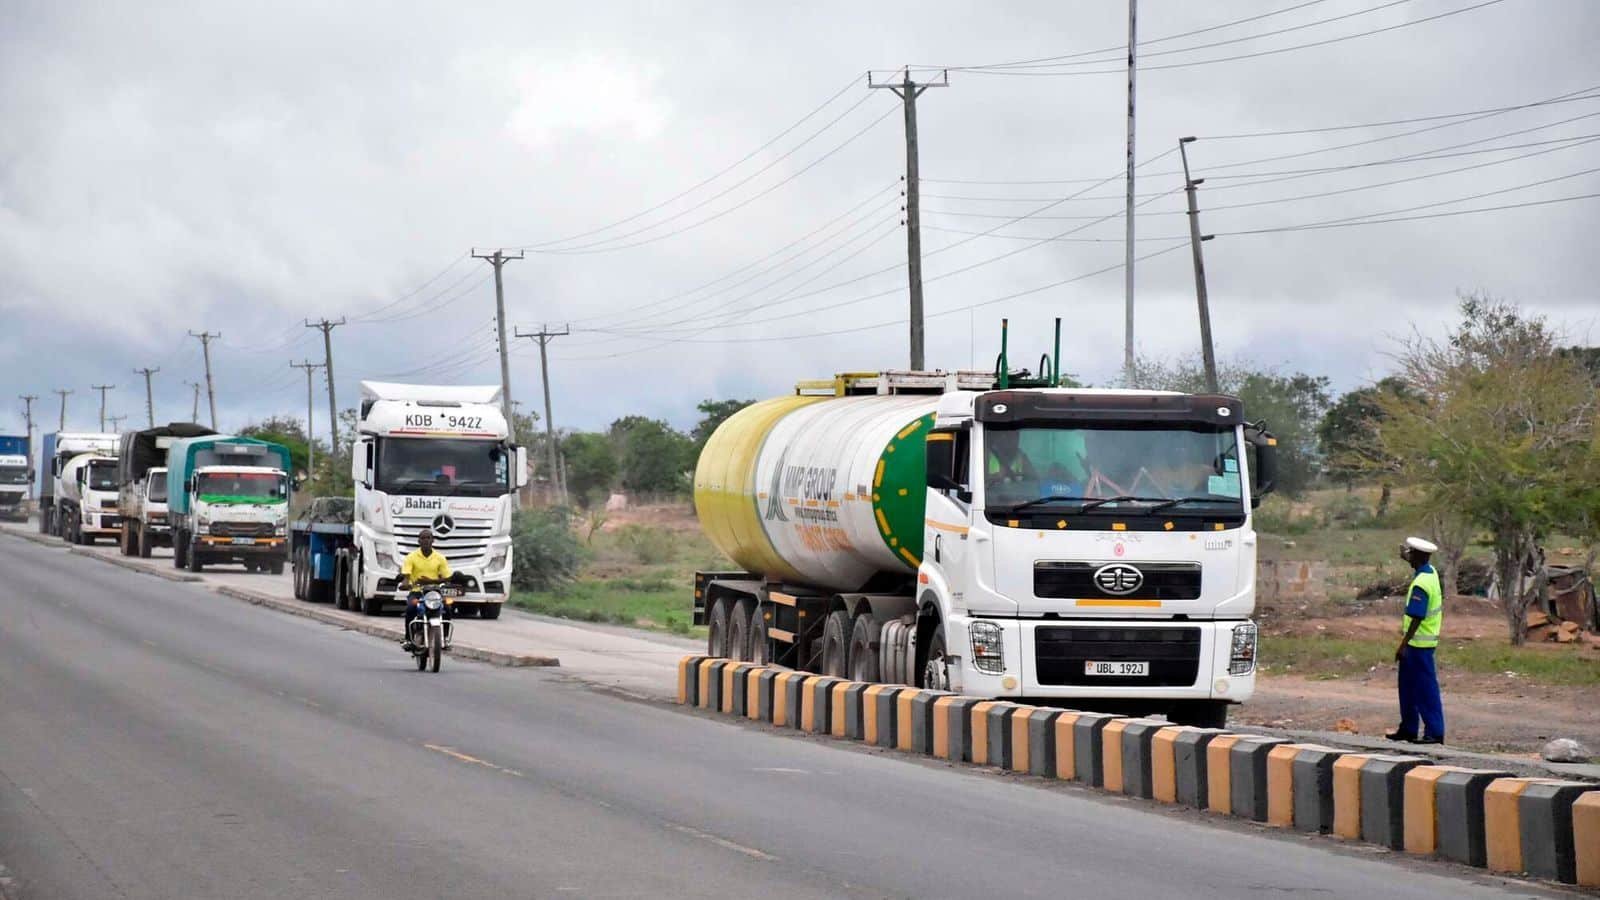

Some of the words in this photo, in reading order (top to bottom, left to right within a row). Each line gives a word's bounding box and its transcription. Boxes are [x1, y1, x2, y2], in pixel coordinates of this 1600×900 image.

[405, 414, 433, 426] KDB
[804, 467, 837, 501] GROUP
[405, 497, 442, 509] Bahari
[1096, 663, 1115, 674] UBL
[1119, 663, 1144, 674] 192J
